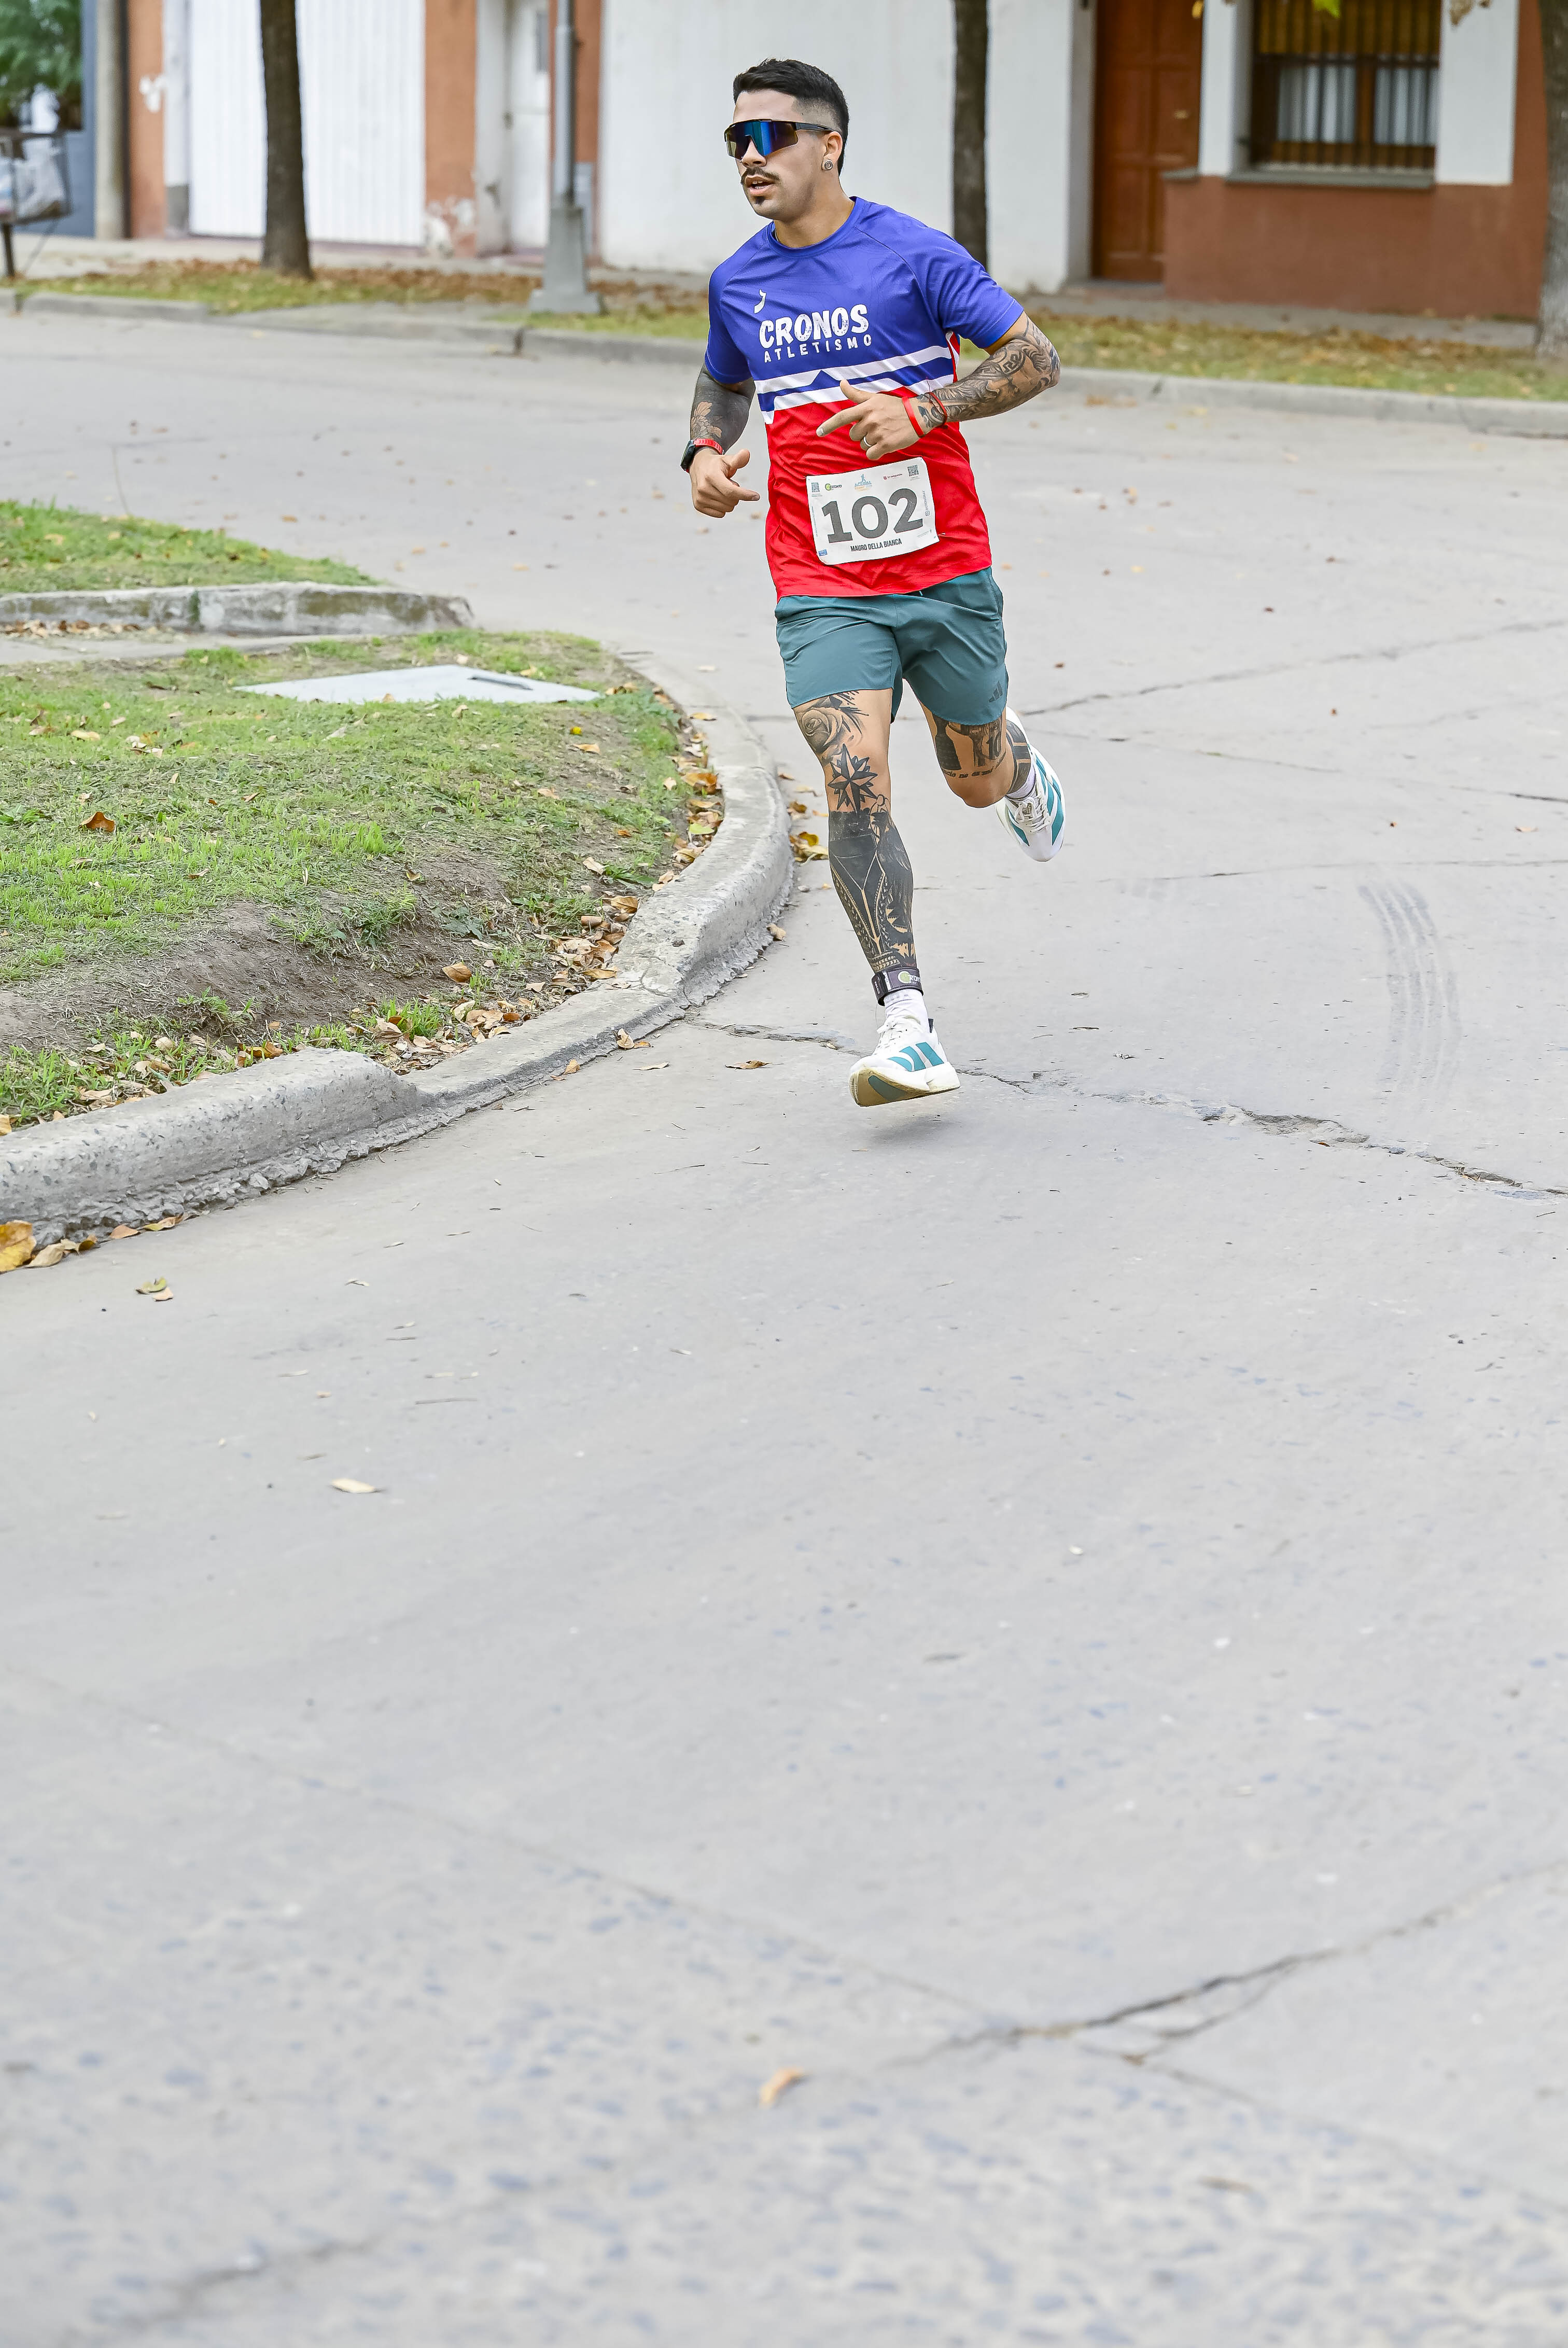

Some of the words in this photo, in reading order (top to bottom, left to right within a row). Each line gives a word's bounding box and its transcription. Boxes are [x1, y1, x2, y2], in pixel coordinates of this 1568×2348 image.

[759, 304, 869, 349] CRONOS
[764, 333, 872, 363] ATLETISMO
[821, 488, 923, 543] 102
[884, 538, 902, 548] BIANCA
